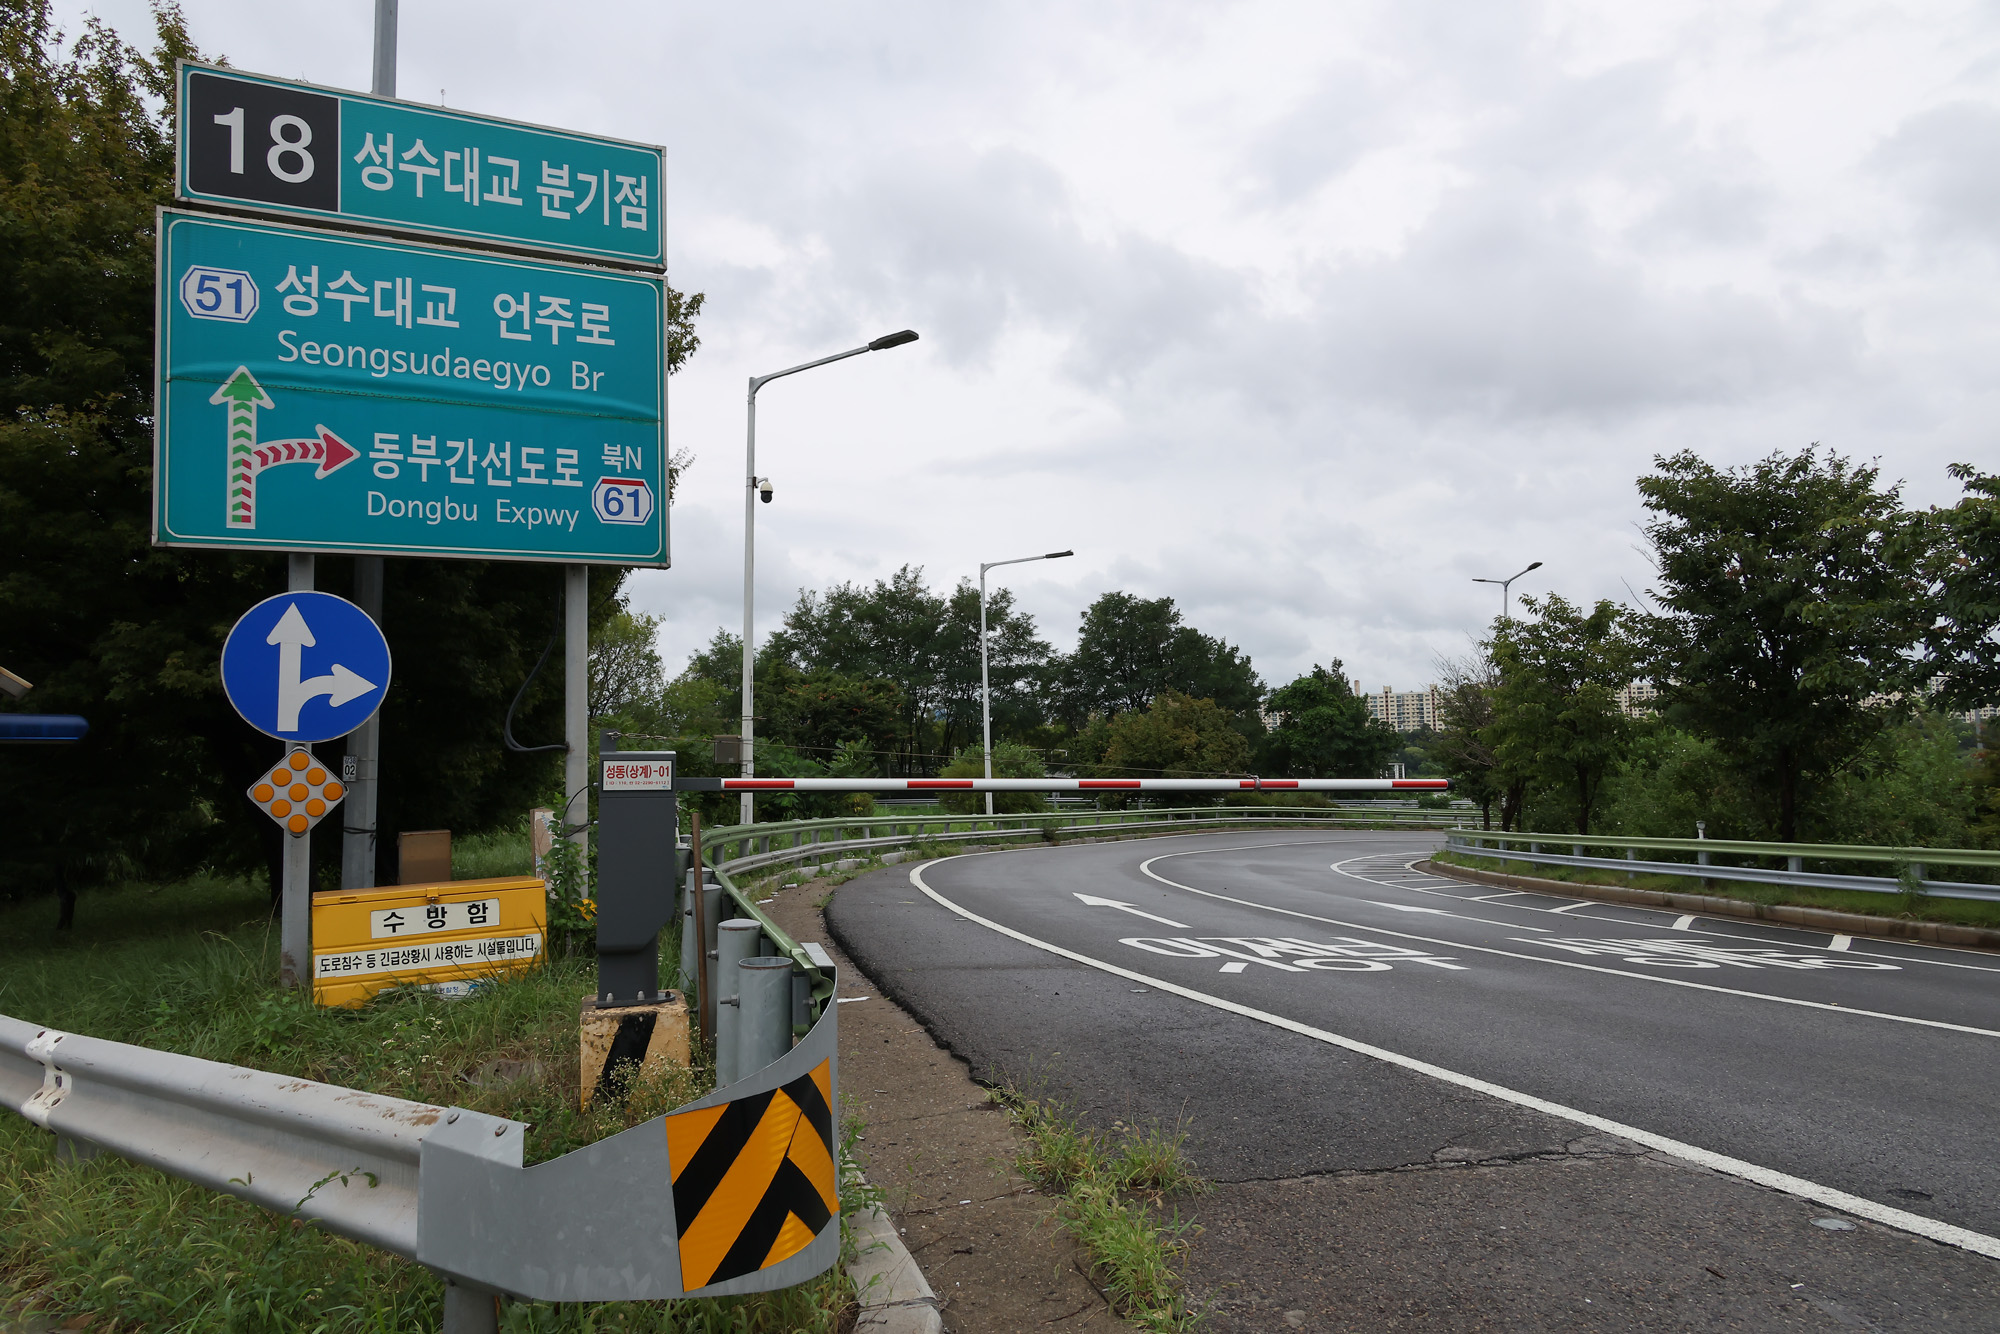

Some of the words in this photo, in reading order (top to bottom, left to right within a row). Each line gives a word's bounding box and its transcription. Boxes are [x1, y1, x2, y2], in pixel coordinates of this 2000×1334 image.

[213, 106, 315, 183] 18
[354, 132, 523, 206] 성수대교
[536, 161, 648, 231] 분기점
[195, 274, 244, 315] 51
[275, 264, 460, 329] 성수대교
[493, 291, 616, 346] 언주로
[278, 330, 552, 391] Seongsudaegyo
[571, 361, 605, 392] Br
[369, 432, 584, 488] 동부간선도로
[601, 443, 642, 473] 북N
[367, 490, 478, 525] Dongbu
[496, 498, 580, 532] Expwy
[602, 486, 641, 518] 61
[344, 765, 356, 776] 02
[605, 764, 670, 780] 성동(상계)-01
[320, 954, 363, 973] 도로침수
[366, 953, 377, 969] 등
[380, 947, 431, 968] 긴급상황시
[434, 943, 474, 961] 사용하는
[1118, 936, 1470, 974] 의정부
[1504, 937, 1903, 970] 상계동
